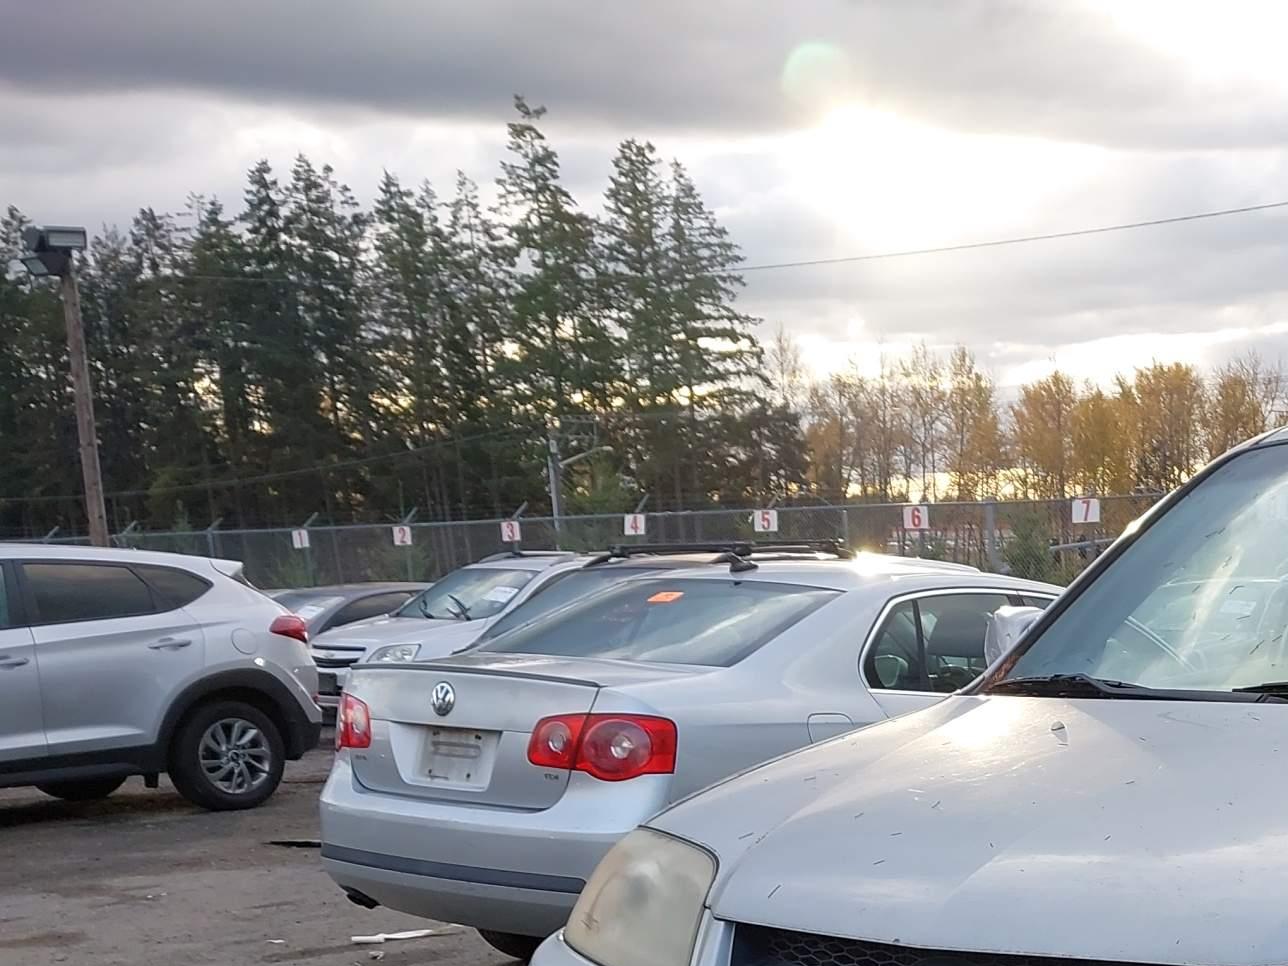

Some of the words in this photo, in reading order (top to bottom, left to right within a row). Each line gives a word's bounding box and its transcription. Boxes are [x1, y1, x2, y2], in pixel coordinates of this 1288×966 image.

[761, 511, 771, 530] 5
[911, 507, 922, 528] 6
[1081, 500, 1092, 522] 7
[506, 521, 515, 540] 3
[630, 515, 640, 534] 4
[399, 527, 408, 544] 2
